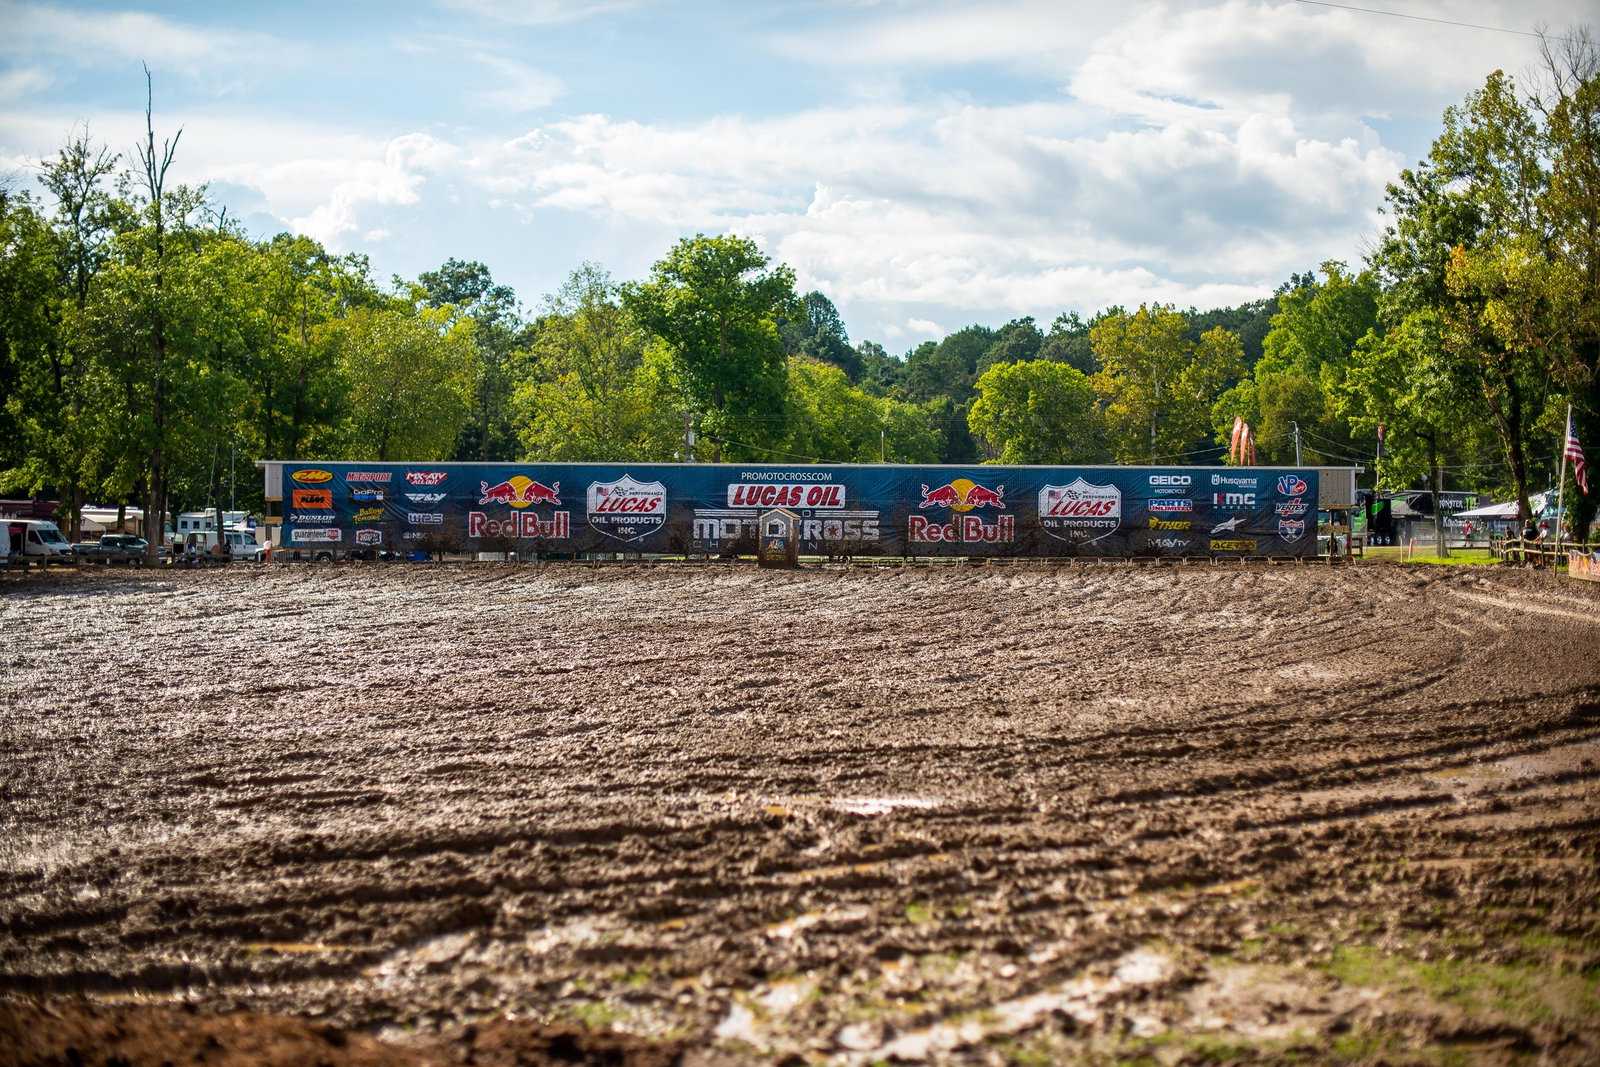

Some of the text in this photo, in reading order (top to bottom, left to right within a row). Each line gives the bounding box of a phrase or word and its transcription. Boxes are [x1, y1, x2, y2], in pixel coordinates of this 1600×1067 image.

[741, 472, 832, 481] PROMOTOCROSS.COM
[1149, 475, 1191, 485] GEICO
[1220, 477, 1257, 485] Husqvarna
[1278, 474, 1299, 494] VP
[301, 495, 325, 503] KTM
[732, 486, 842, 506] LUCAS OIL
[596, 497, 662, 512] LUCAS
[1047, 500, 1116, 516] LUCAS
[468, 510, 570, 538] Red Bull
[592, 516, 662, 525] OIL PRODUCTS
[1044, 520, 1117, 528] OIL PRODUCTS
[1159, 521, 1192, 530] THOR
[909, 514, 1014, 543] Red Bull
[294, 530, 327, 540] guaranteed
